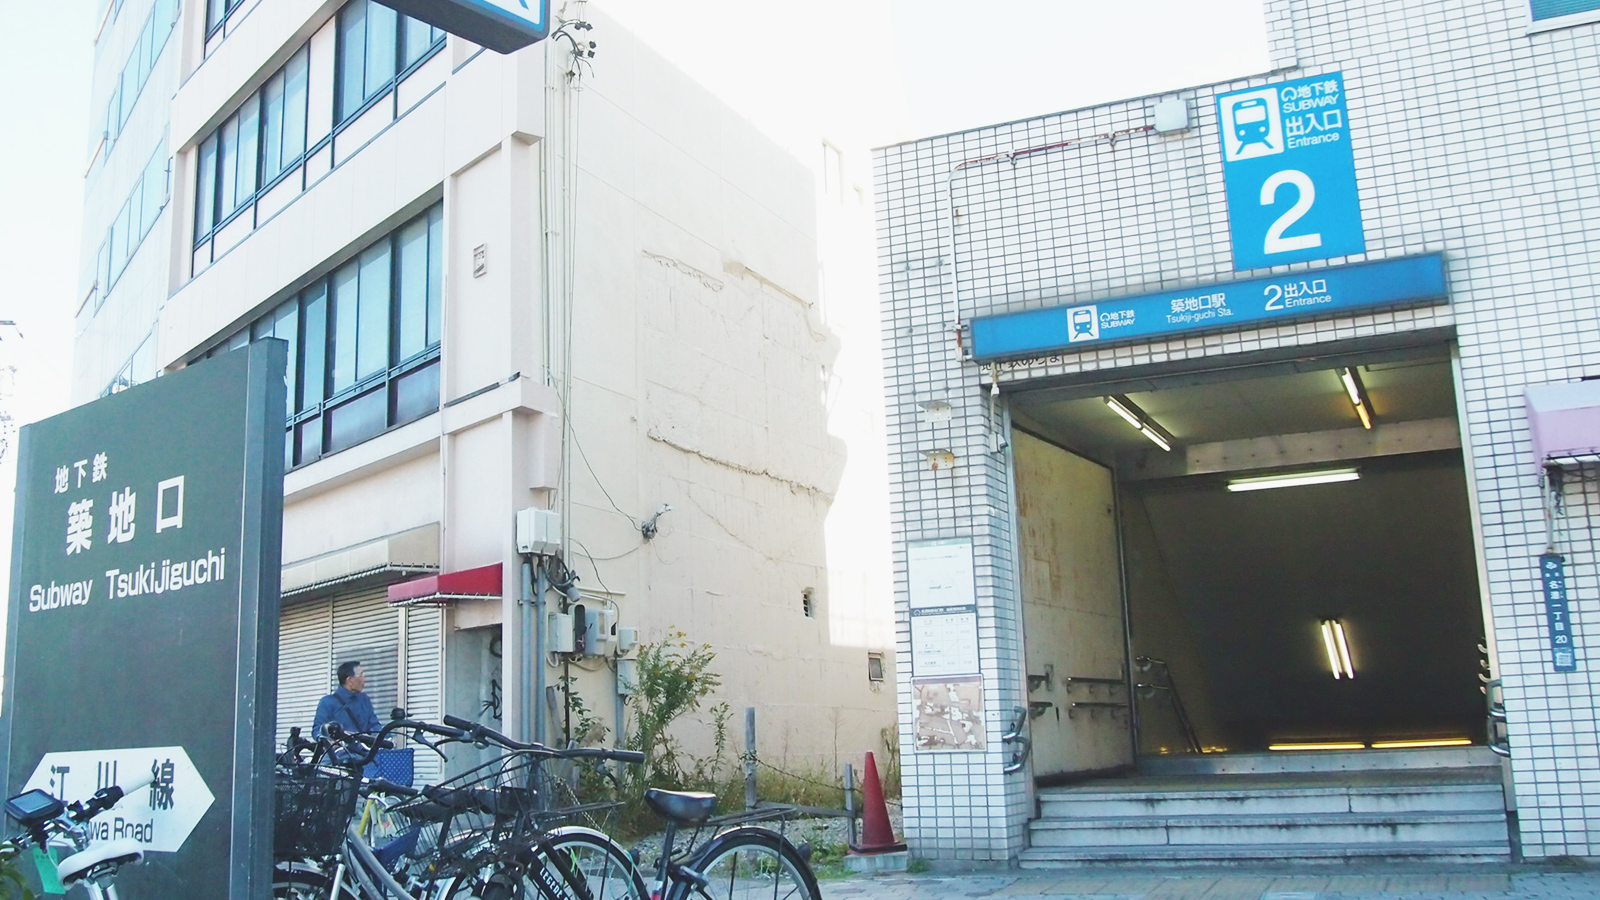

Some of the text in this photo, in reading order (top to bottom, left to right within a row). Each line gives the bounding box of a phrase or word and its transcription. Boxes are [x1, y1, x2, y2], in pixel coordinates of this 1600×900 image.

[1297, 79, 1339, 98] 地下鉄
[1283, 94, 1340, 113] SUBWAY
[1285, 109, 1343, 137] 出入口
[1287, 132, 1340, 149] Entrance
[1260, 169, 1322, 255] 2
[1171, 292, 1226, 314] 築地口駅
[1263, 279, 1327, 311] 2 出入口
[1285, 293, 1332, 309] Entrance
[1101, 318, 1135, 329] SUBWAY
[1110, 309, 1135, 320] 地下鉄
[1166, 307, 1234, 324] Tsukiji-guchi Sta.
[54, 452, 108, 494] 地下鉄
[66, 475, 184, 556] 築地口
[29, 548, 226, 612] Subway Tsukijiguchi
[1555, 635, 1567, 644] 20
[114, 817, 154, 843] Road
